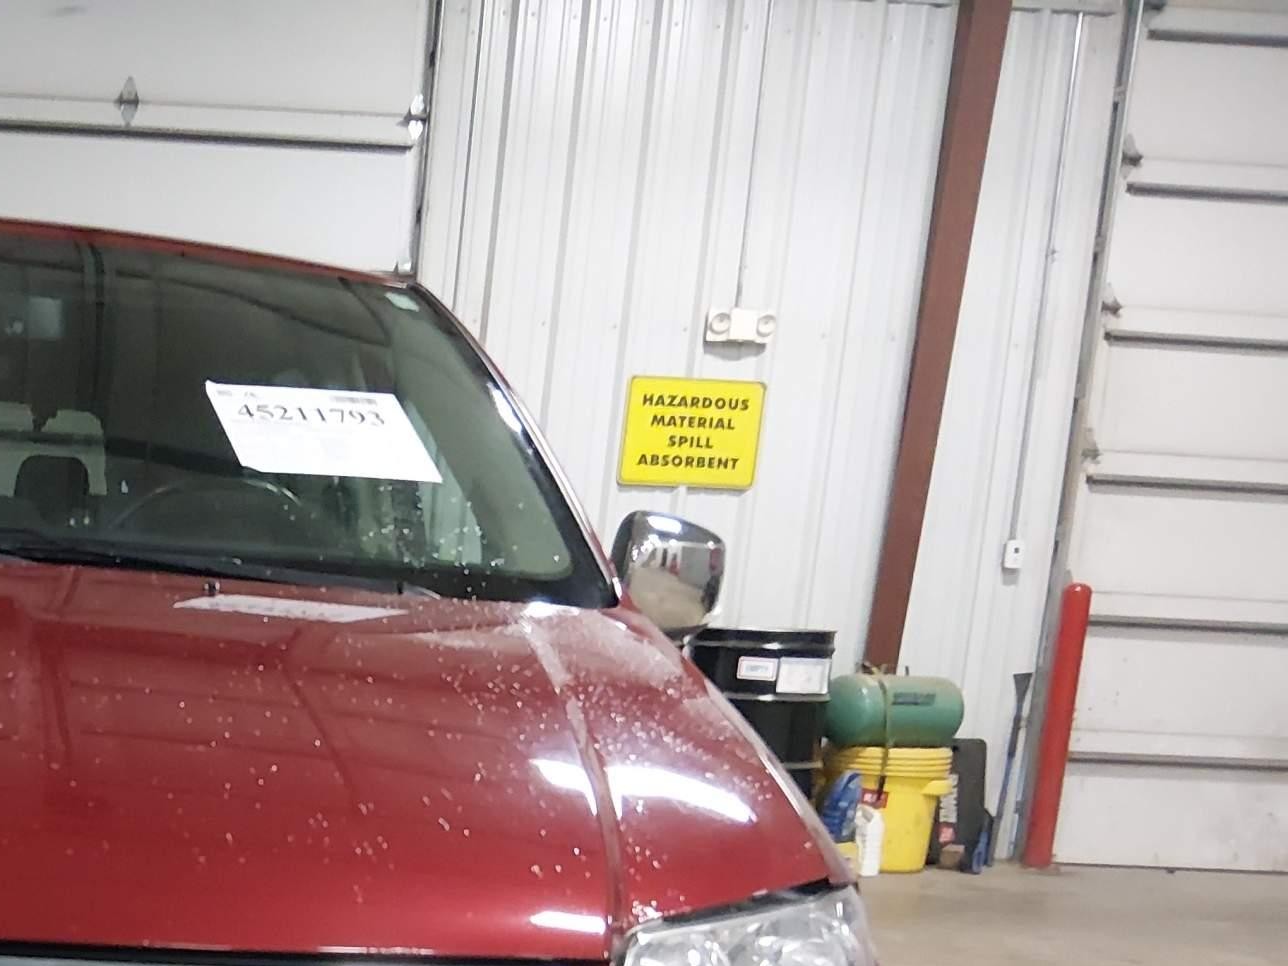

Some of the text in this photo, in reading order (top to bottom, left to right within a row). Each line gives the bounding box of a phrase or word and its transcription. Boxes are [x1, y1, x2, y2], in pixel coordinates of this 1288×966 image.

[642, 394, 750, 411] HAZARDOUS
[238, 403, 385, 426] 45211793
[650, 414, 735, 430] MATERIAL
[667, 435, 713, 449] SPILL
[636, 454, 740, 470] ABSORBENT
